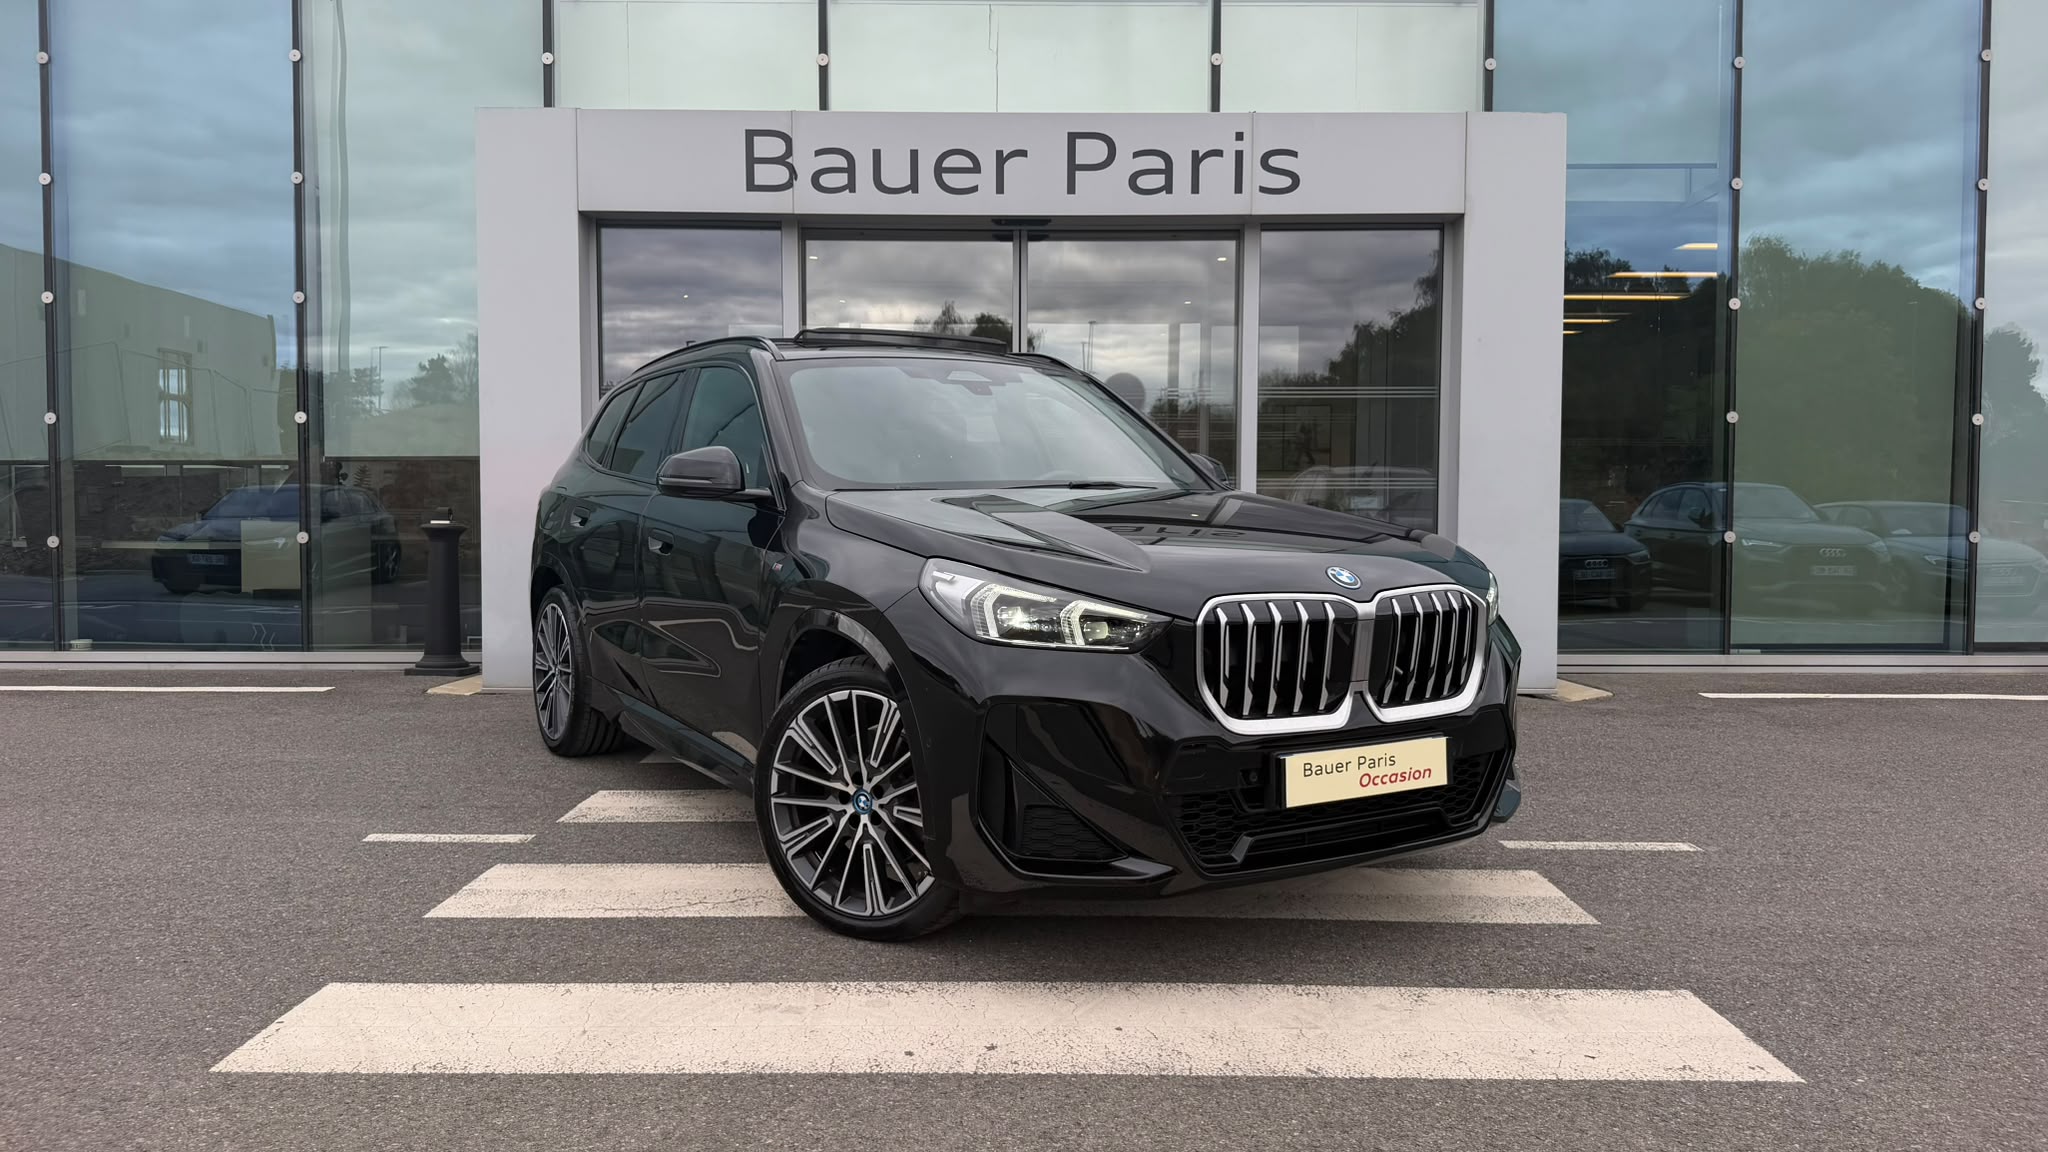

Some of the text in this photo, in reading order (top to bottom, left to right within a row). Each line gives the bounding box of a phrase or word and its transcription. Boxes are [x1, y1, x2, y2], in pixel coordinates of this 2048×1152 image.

[744, 128, 1301, 196] Bauer Paris
[1303, 753, 1396, 778] Bauer Paris
[1359, 767, 1432, 788] Occasion
